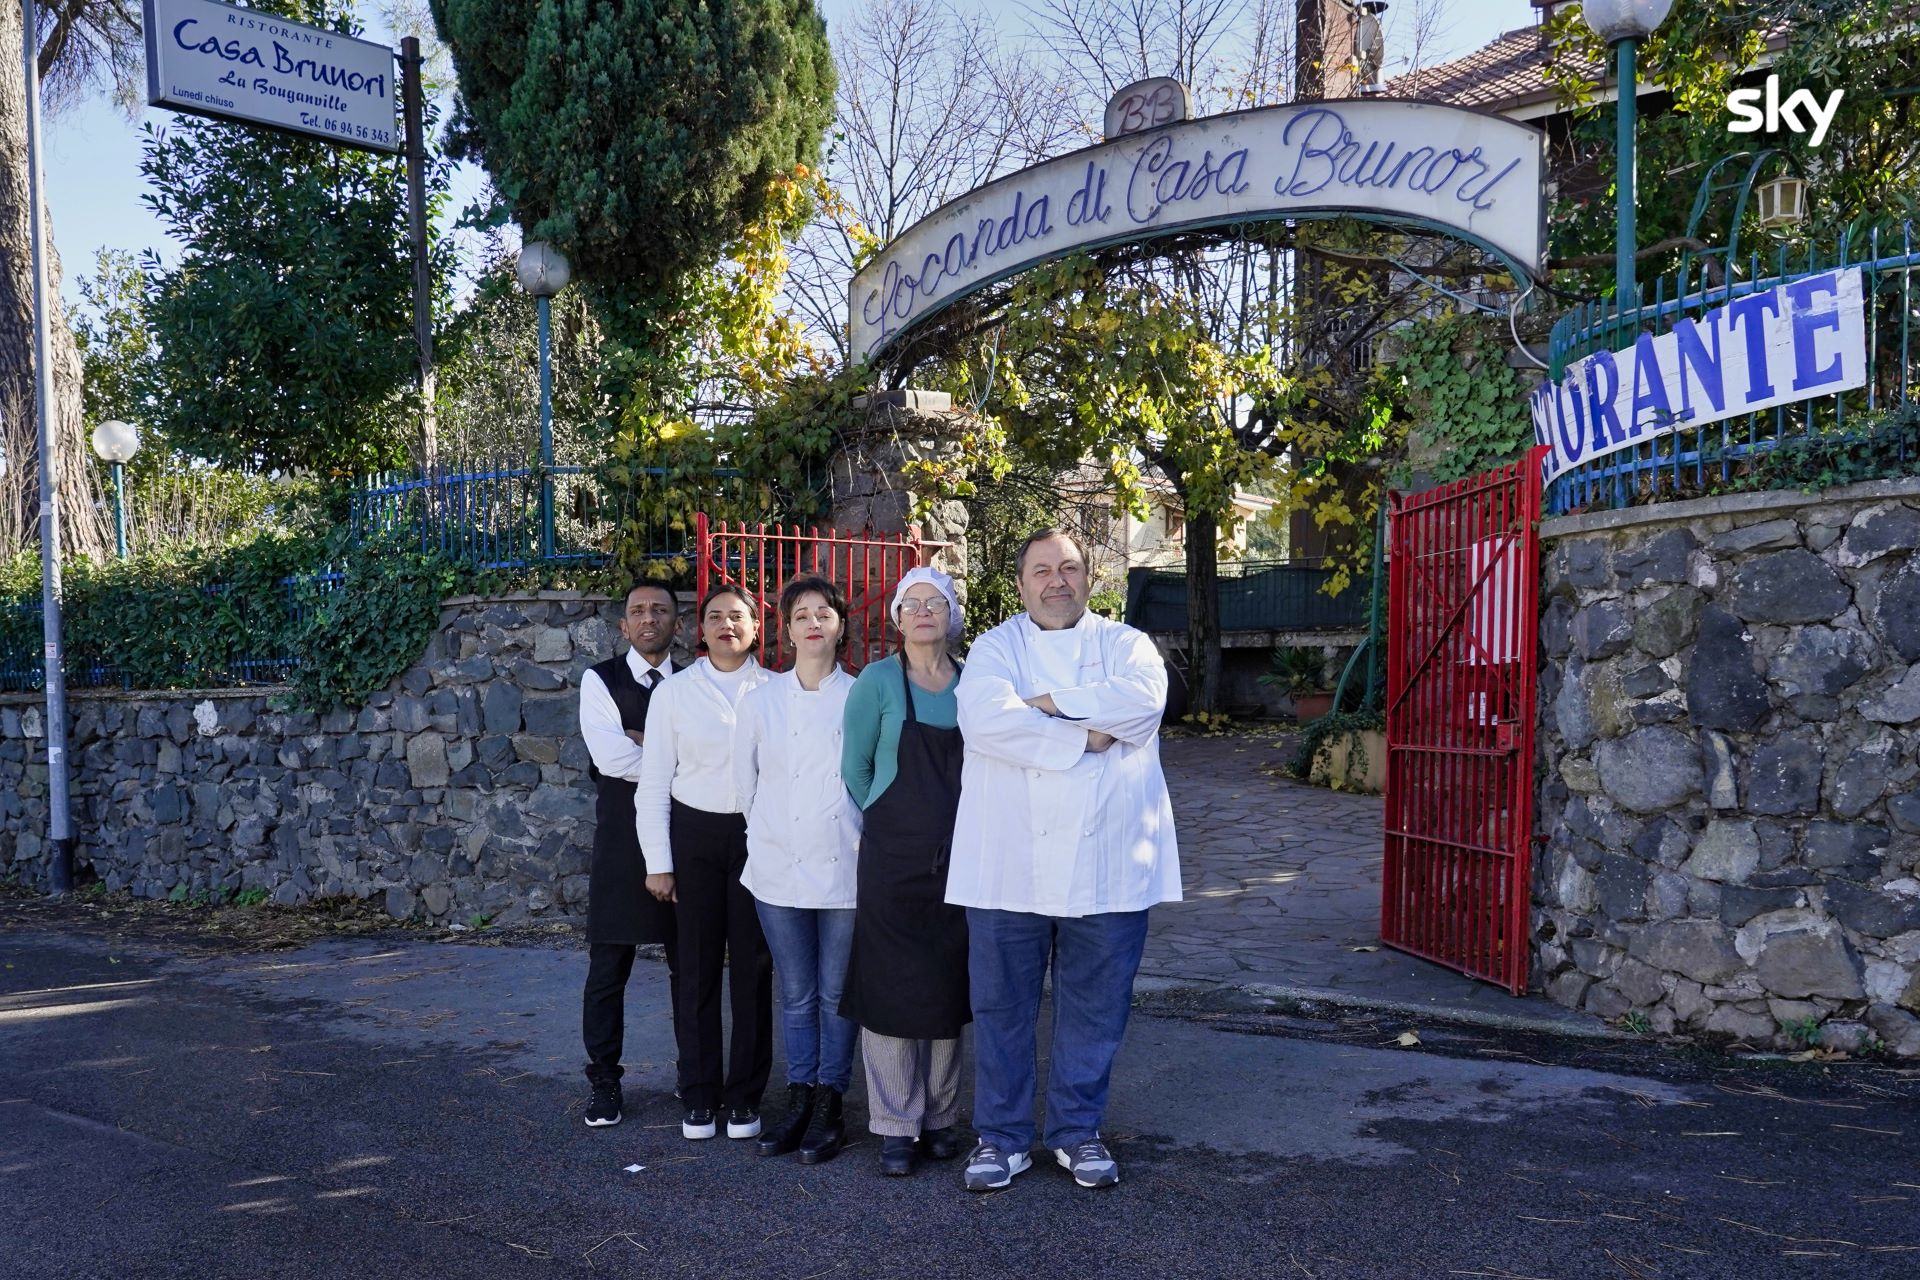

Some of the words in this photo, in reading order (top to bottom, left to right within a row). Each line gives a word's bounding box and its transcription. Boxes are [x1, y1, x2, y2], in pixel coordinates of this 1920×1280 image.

[228, 14, 333, 49] RISTORANTE
[173, 19, 266, 68] Casa
[272, 40, 385, 98] Brunori
[204, 94, 235, 109] chiuso
[218, 70, 246, 88] La
[252, 78, 348, 112] Bouganville
[1117, 84, 1175, 134] BB
[300, 112, 321, 128] Tel.
[324, 118, 337, 131] 06
[340, 121, 353, 135] 94
[356, 125, 369, 138] 56
[371, 128, 390, 143] 343
[863, 191, 1054, 359] Locanda
[1066, 160, 1112, 226] di
[1126, 135, 1250, 224] Casa
[1274, 108, 1522, 210] Brunori
